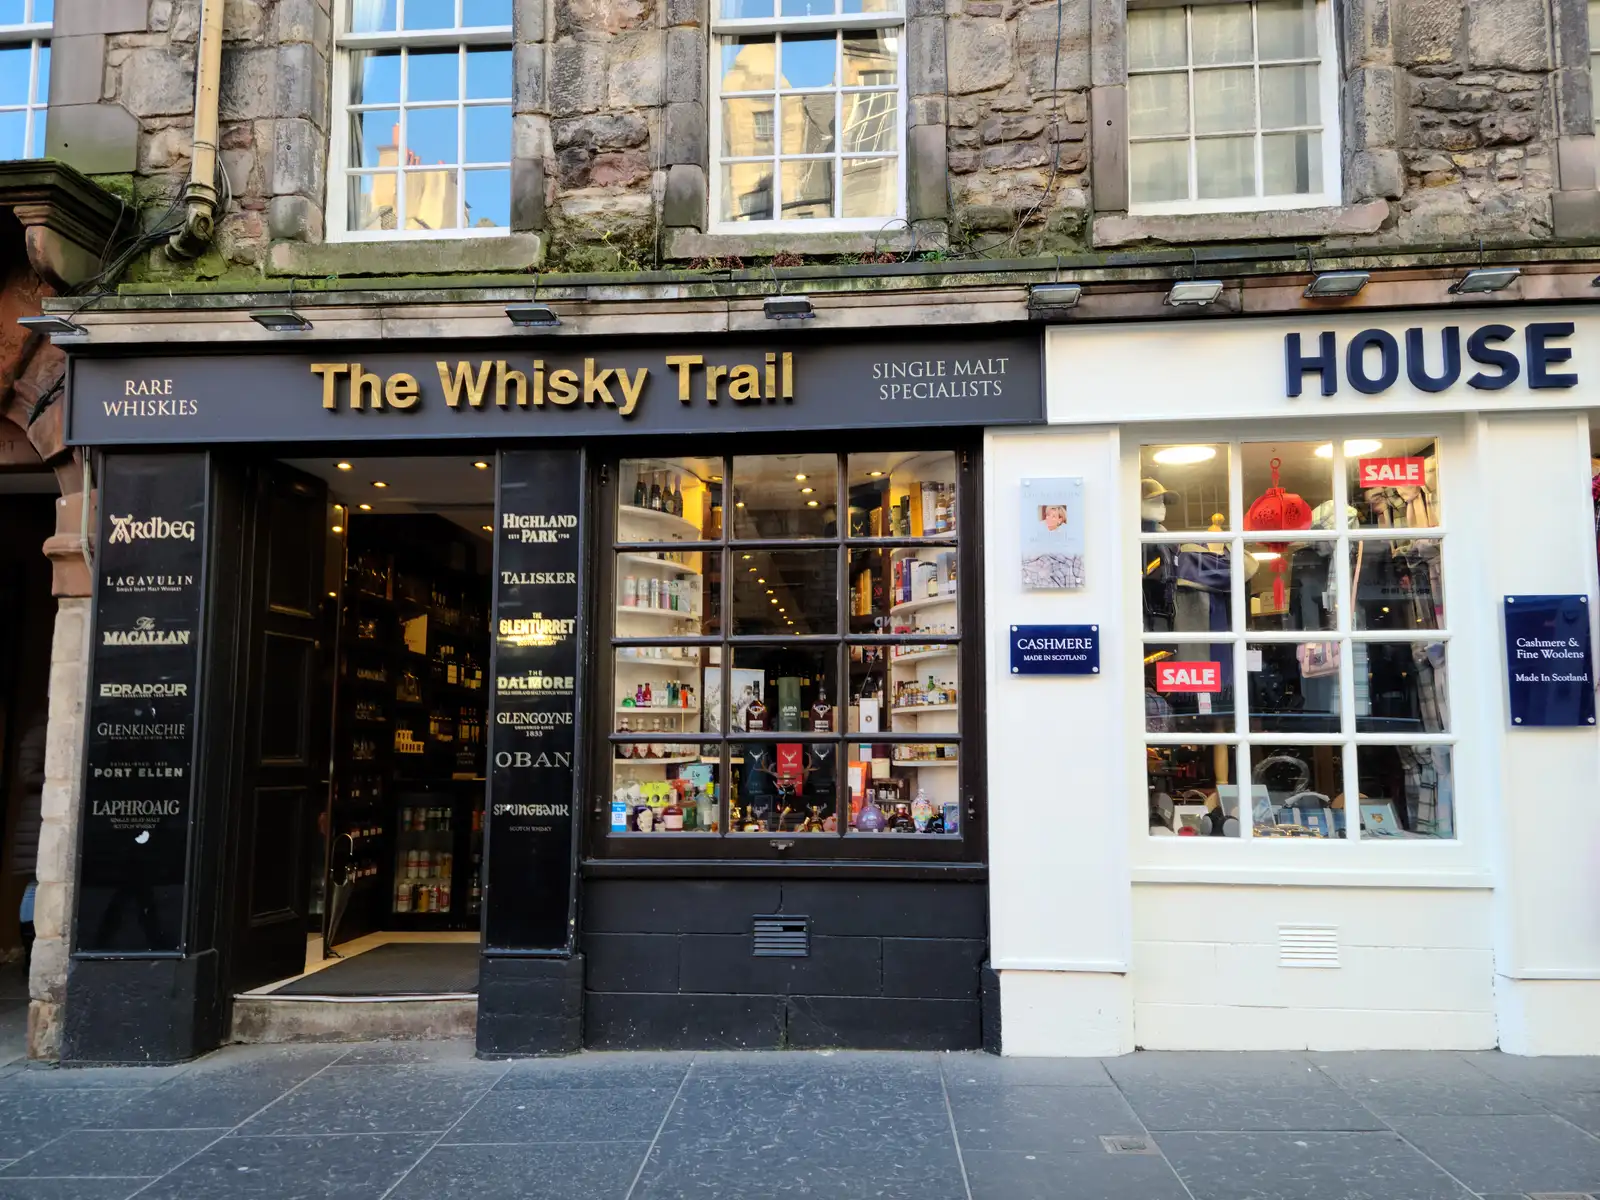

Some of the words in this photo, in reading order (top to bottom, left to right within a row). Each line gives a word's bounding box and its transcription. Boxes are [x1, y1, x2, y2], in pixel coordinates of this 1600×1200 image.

[1284, 322, 1578, 397] HOUSE
[872, 360, 946, 379] SINGLE
[953, 358, 1009, 376] MALT
[125, 379, 173, 395] RARE
[310, 363, 421, 410] The
[436, 357, 649, 416] Whisky
[665, 352, 793, 403] Trail
[879, 380, 1002, 400] SPECIALISTS
[102, 399, 198, 417] WHISKIES
[1365, 463, 1418, 480] SALE
[503, 513, 577, 528] HIGHLAND
[108, 514, 195, 544] Ardbeg
[521, 529, 558, 543] PARK
[107, 575, 193, 586] LAGAVULIN
[501, 571, 576, 584] TALISKER
[133, 616, 156, 630] The
[499, 619, 575, 634] GLENTURRET
[103, 630, 190, 645] MACALLAN
[1017, 638, 1093, 650] CASHMERE
[1516, 637, 1566, 647] Cashmere
[1568, 637, 1579, 647] &
[1516, 649, 1539, 659] Fine
[1541, 649, 1585, 659] Woolens
[497, 676, 574, 690] DALMORE
[1162, 668, 1215, 685] SALE
[1515, 673, 1539, 682] Made
[1541, 673, 1550, 682] In
[1552, 673, 1588, 682] Scotland
[100, 683, 187, 697] EDRADOUR
[496, 712, 573, 724] GLENGOYNE
[97, 722, 185, 736] GLENKINCHIE
[495, 751, 571, 768] OBAN
[94, 768, 132, 777] PORT
[138, 767, 183, 777] ELLEN
[92, 800, 180, 815] LAPHROAIG
[493, 804, 569, 816] SPRINGBANK
